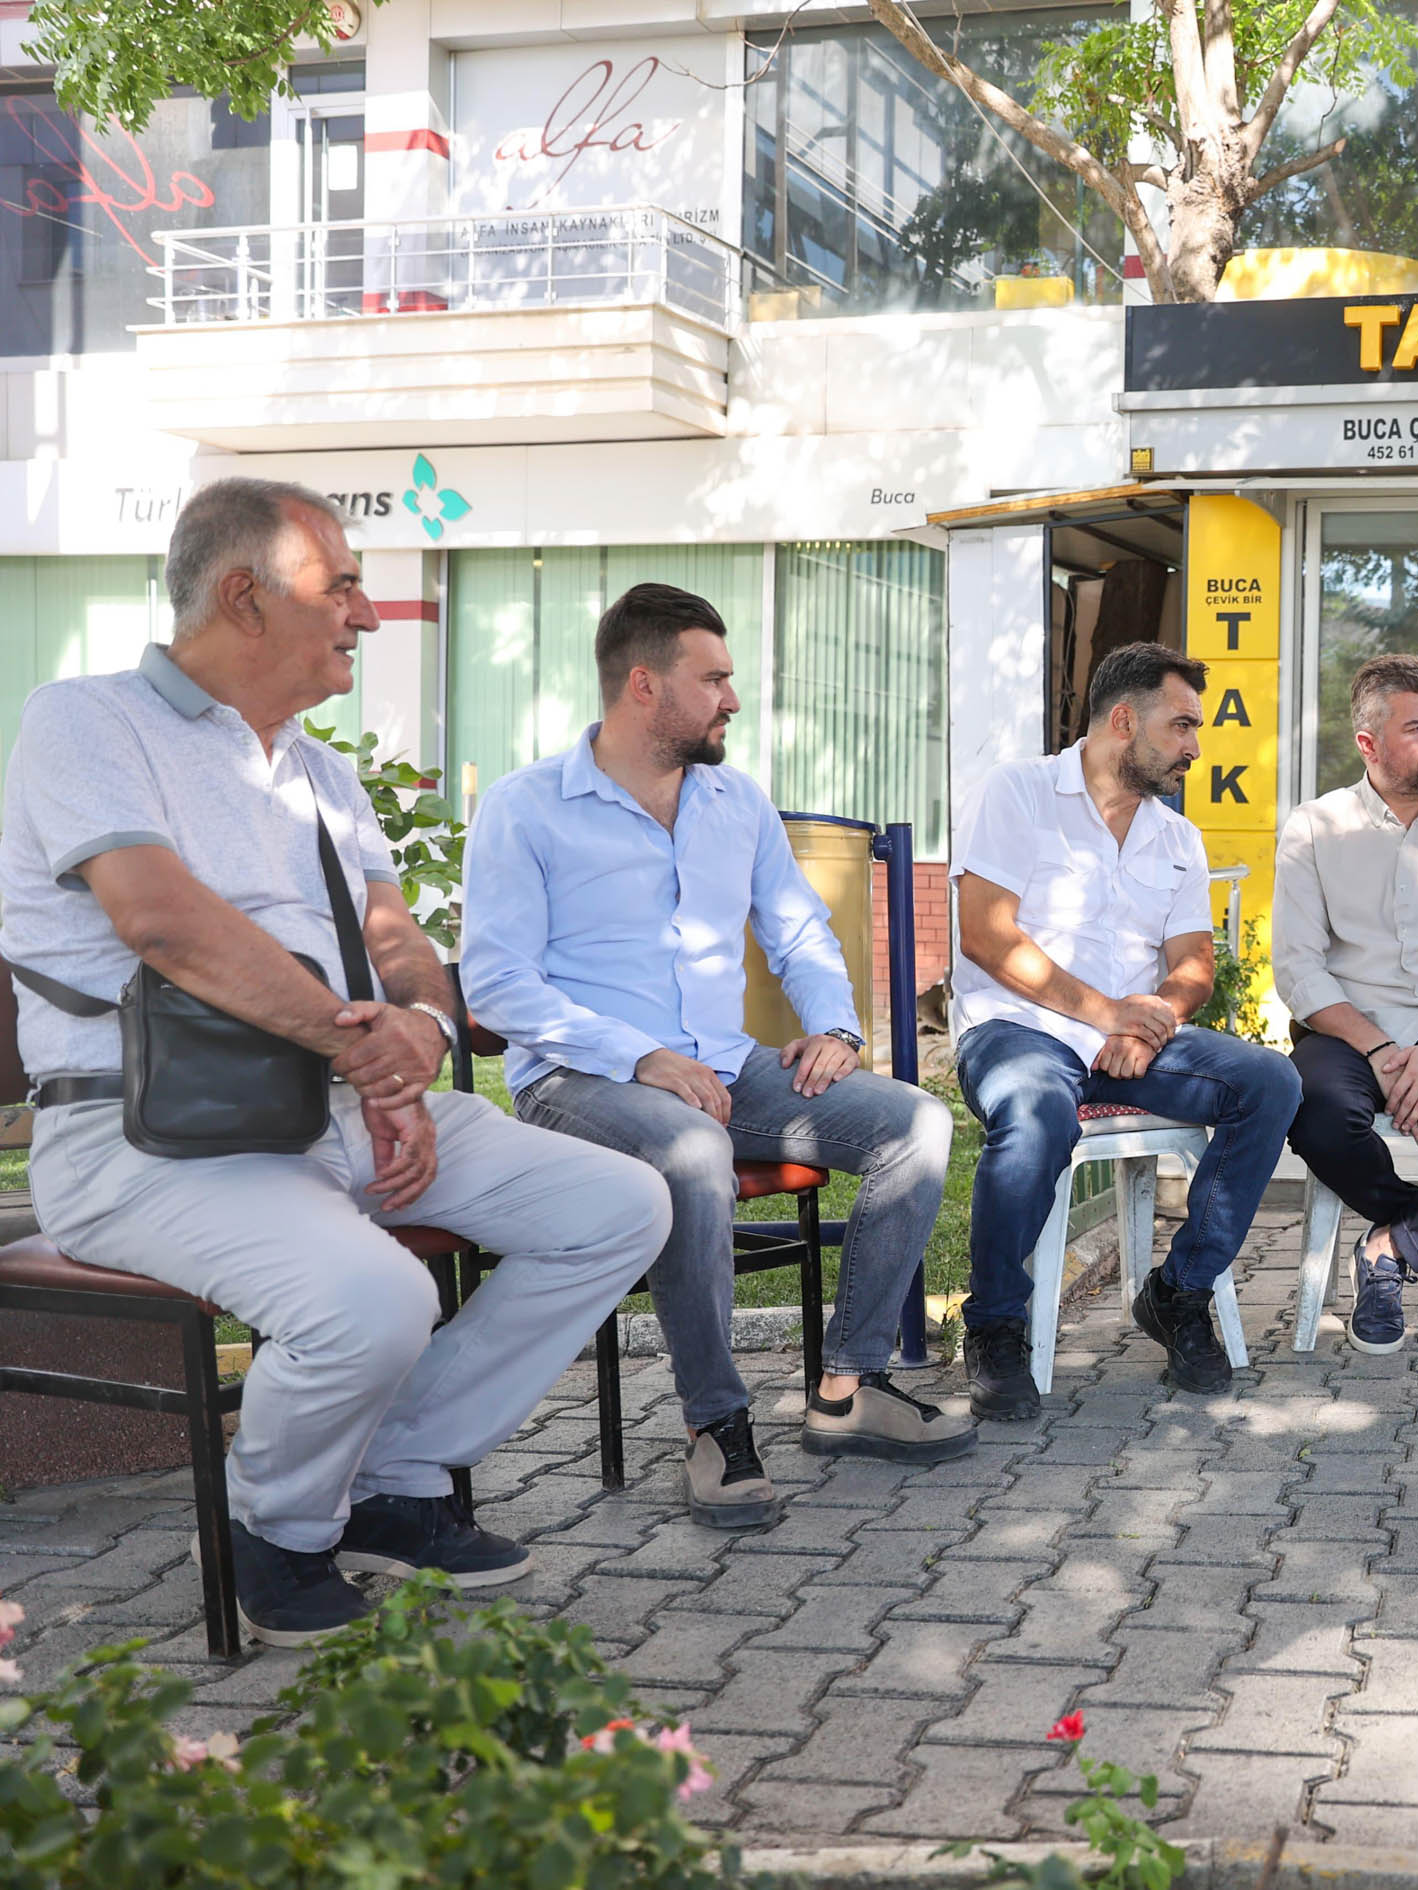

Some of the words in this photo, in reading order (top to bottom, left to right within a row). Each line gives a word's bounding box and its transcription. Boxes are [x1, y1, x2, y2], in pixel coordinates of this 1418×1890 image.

[492, 56, 682, 210] alfa
[1343, 418, 1402, 440] BUCA
[1367, 446, 1393, 459] 452
[1399, 445, 1415, 459] 61
[870, 488, 915, 504] Buca
[1207, 579, 1261, 592] BUCA
[1206, 595, 1239, 605] ÇEVİK
[1243, 594, 1262, 604] BİR
